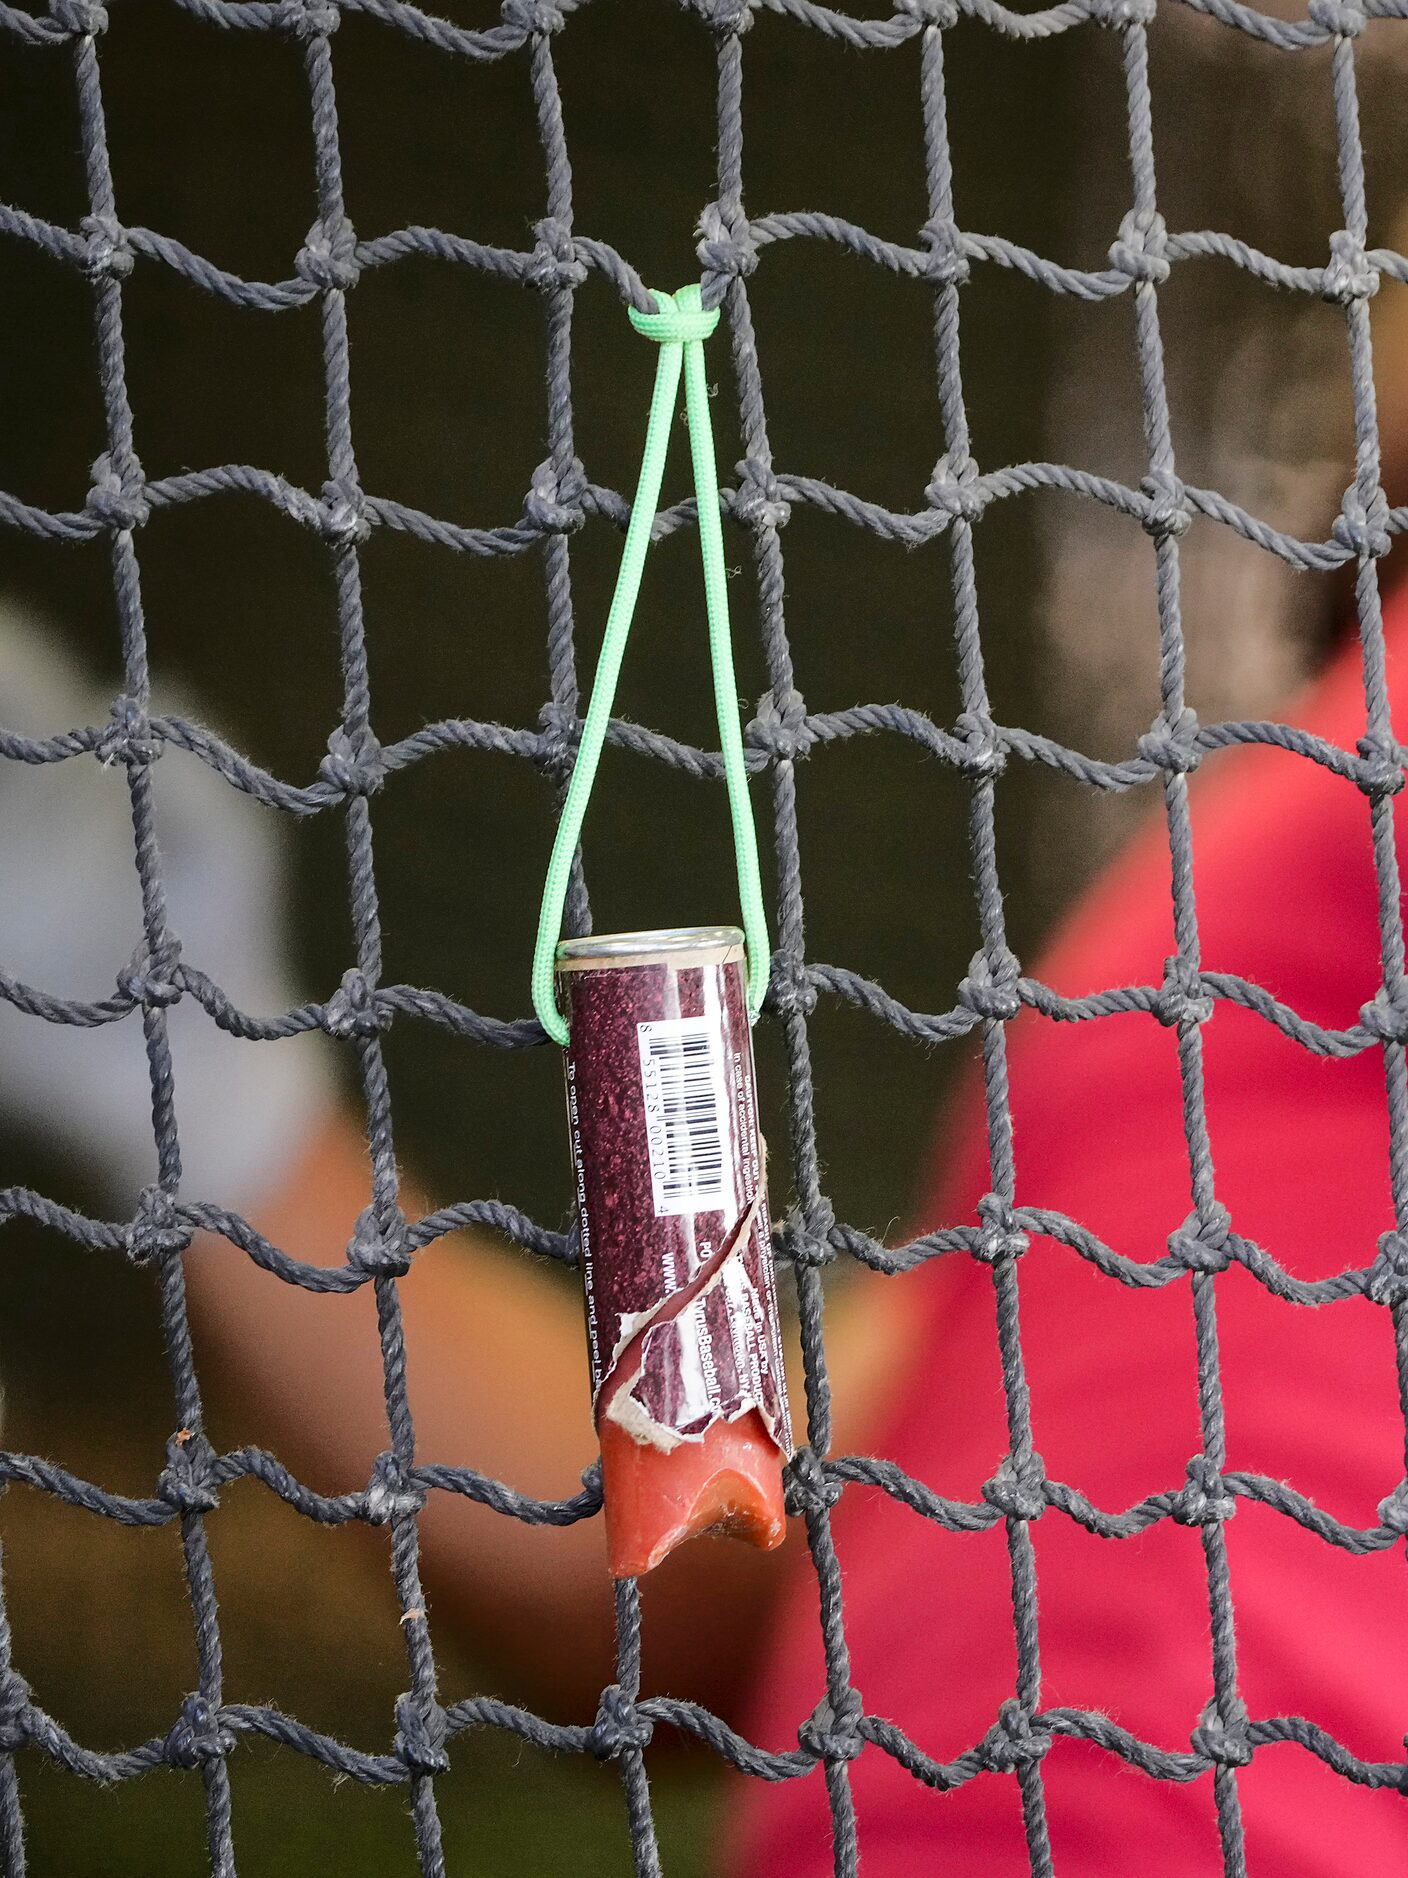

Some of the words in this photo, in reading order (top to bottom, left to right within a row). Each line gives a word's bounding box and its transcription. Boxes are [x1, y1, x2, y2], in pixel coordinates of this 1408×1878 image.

[640, 1024, 651, 1033] 8
[568, 1062, 576, 1080] To
[643, 1058, 659, 1113] 55128
[735, 1064, 743, 1089] case
[568, 1084, 579, 1124] open
[737, 1091, 745, 1101] of
[573, 1129, 582, 1154] cut
[739, 1103, 750, 1156] accidental
[650, 1125, 666, 1180] 00210
[575, 1158, 588, 1202] along
[657, 1206, 669, 1214] 4
[580, 1208, 592, 1257] dotted
[584, 1261, 595, 1290] line
[662, 1252, 677, 1294] www.
[587, 1294, 597, 1324] and
[741, 1292, 756, 1352] BASEBALL
[751, 1288, 762, 1319] Made
[757, 1334, 769, 1360] USA
[590, 1330, 601, 1363] peel
